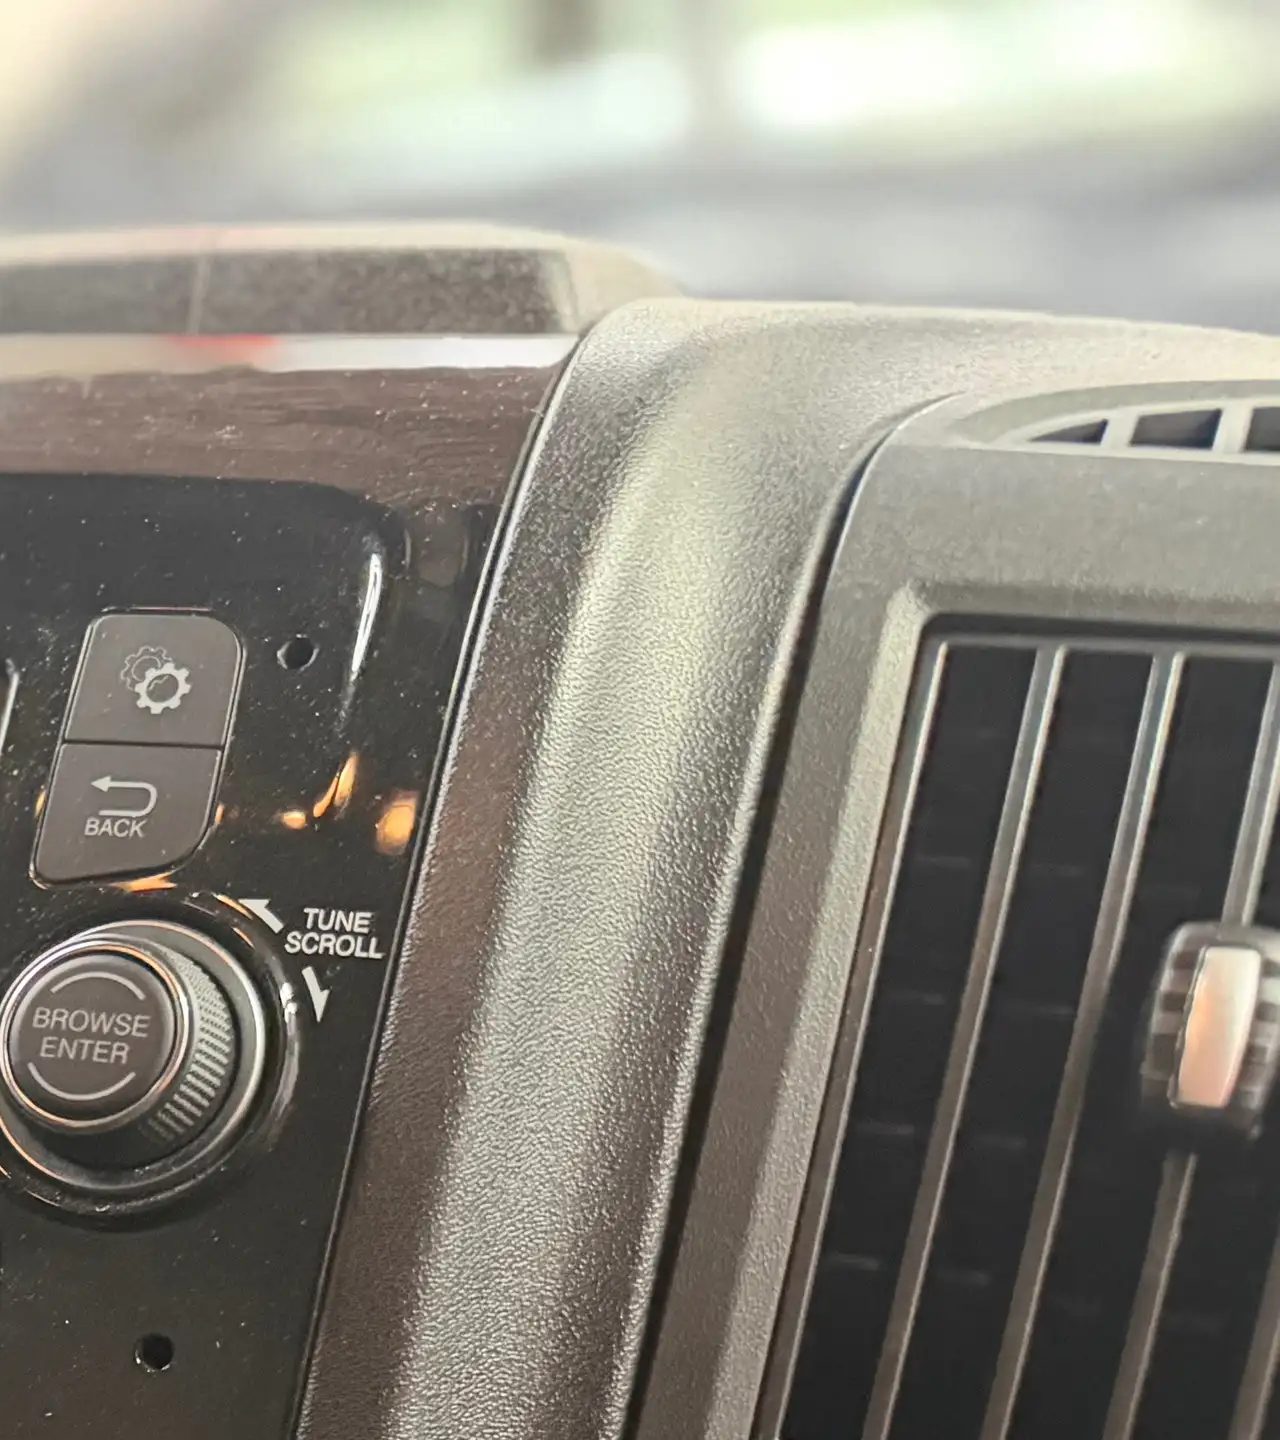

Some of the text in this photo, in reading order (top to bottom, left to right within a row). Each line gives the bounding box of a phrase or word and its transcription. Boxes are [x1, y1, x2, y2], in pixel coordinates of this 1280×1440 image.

[84, 817, 148, 838] BACK
[303, 908, 373, 933] TUNE
[284, 931, 385, 959] SCROLL
[32, 1006, 151, 1037] BROWSE
[40, 1036, 129, 1064] ENTER
